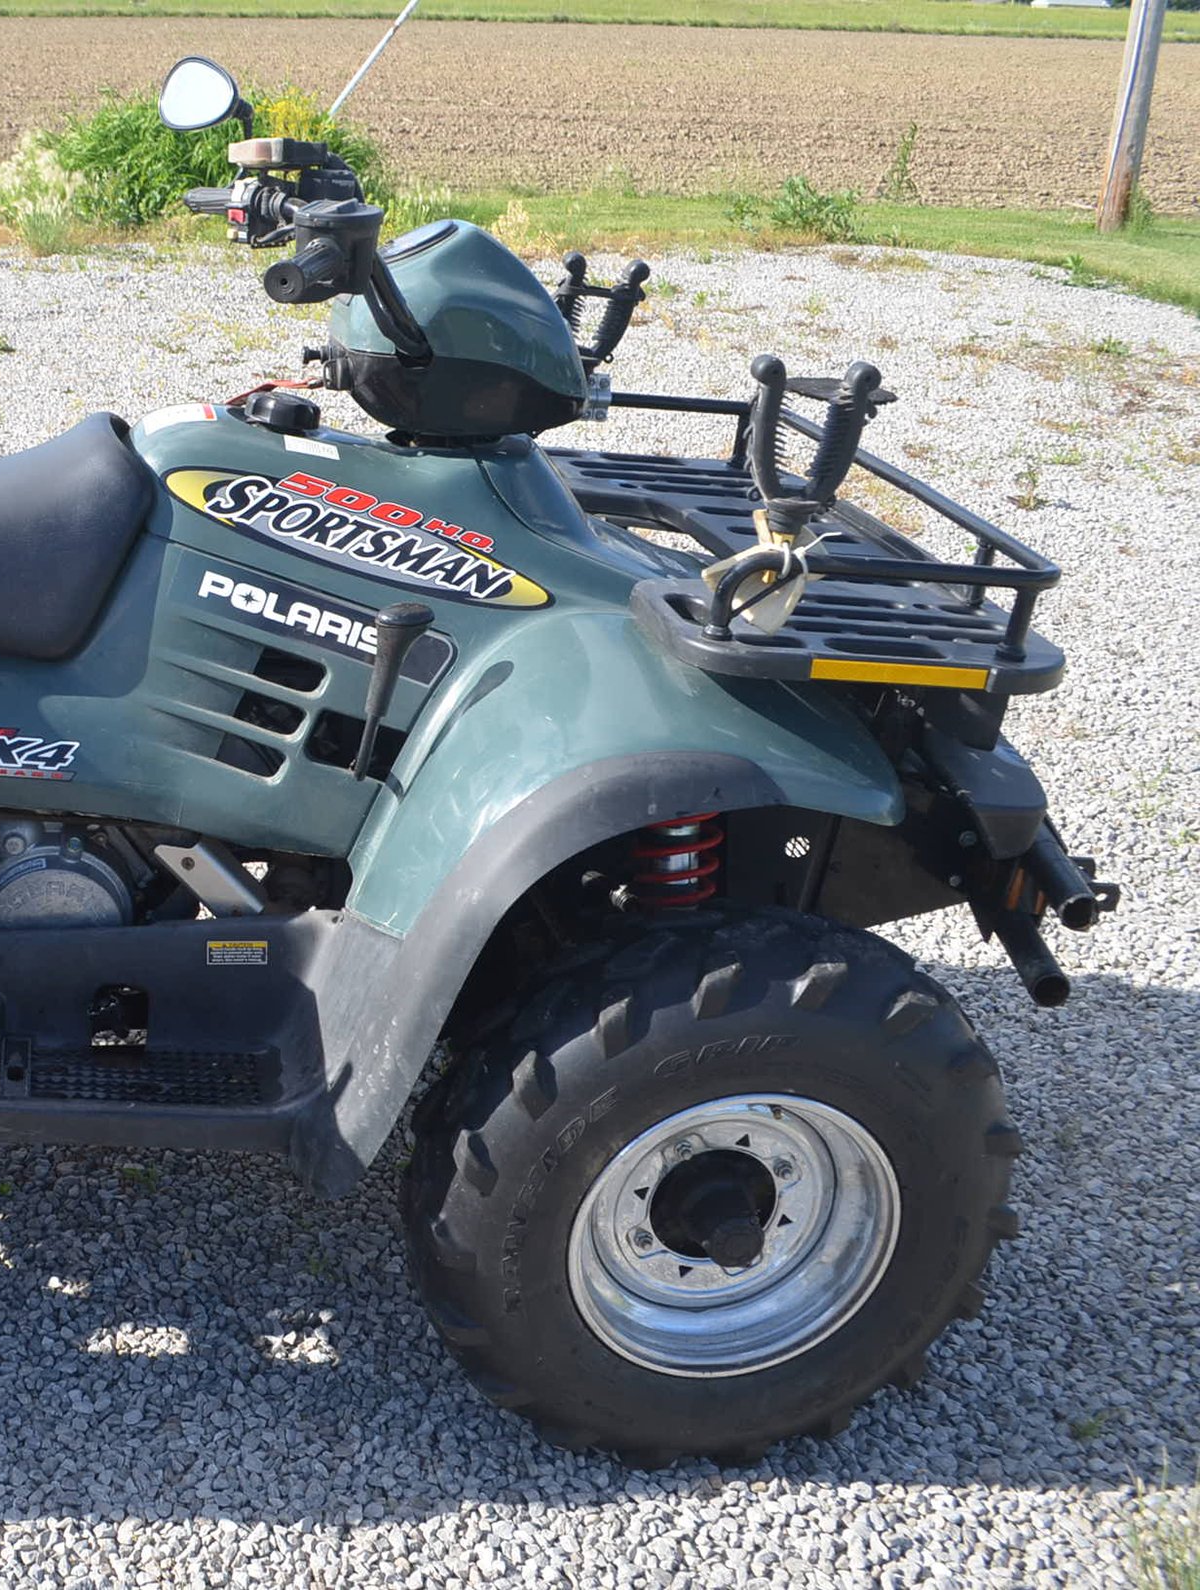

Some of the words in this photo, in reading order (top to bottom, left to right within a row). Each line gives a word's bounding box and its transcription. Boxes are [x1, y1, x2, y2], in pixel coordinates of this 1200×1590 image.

[204, 476, 517, 598] SPORTSMAN
[278, 471, 422, 528] 500
[423, 517, 496, 553] H.O.
[198, 571, 380, 655] POLARIS
